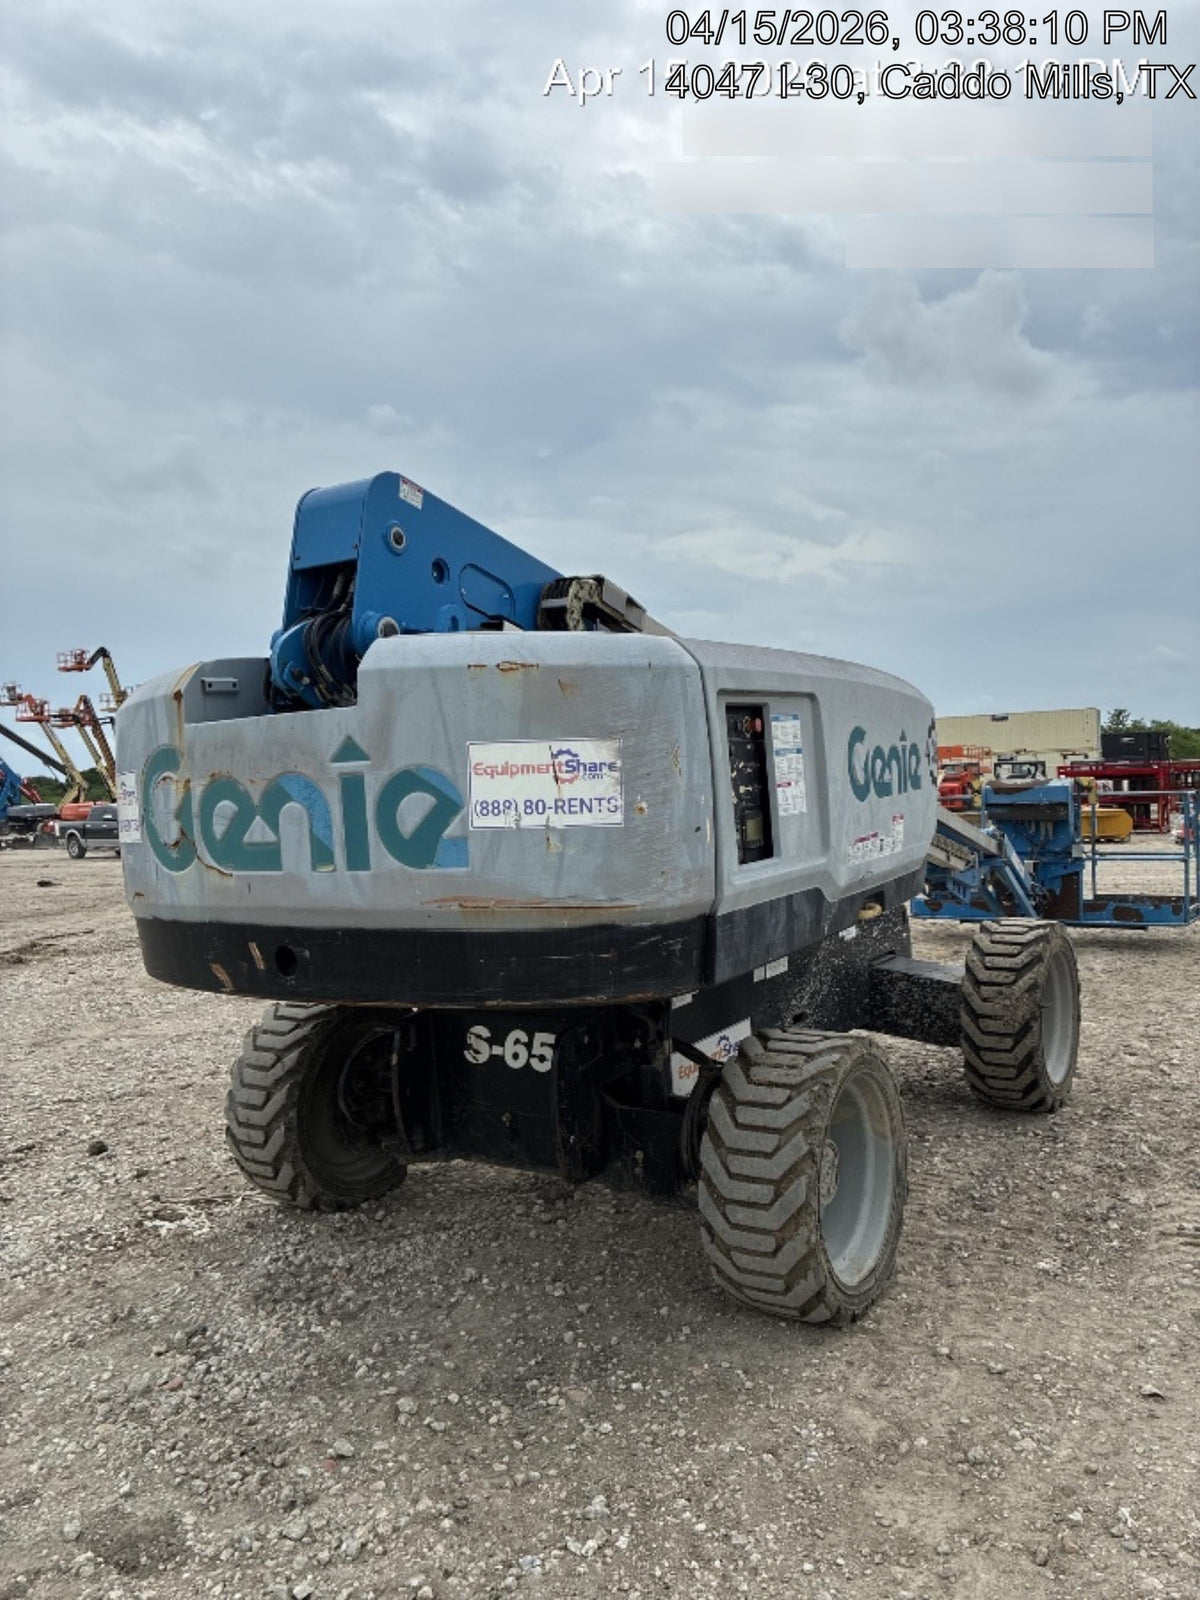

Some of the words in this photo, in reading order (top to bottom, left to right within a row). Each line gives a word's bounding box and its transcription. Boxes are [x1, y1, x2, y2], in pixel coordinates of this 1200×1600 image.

[847, 725, 922, 803] Genie
[141, 735, 470, 873] Genie
[463, 1024, 556, 1073] S-65
